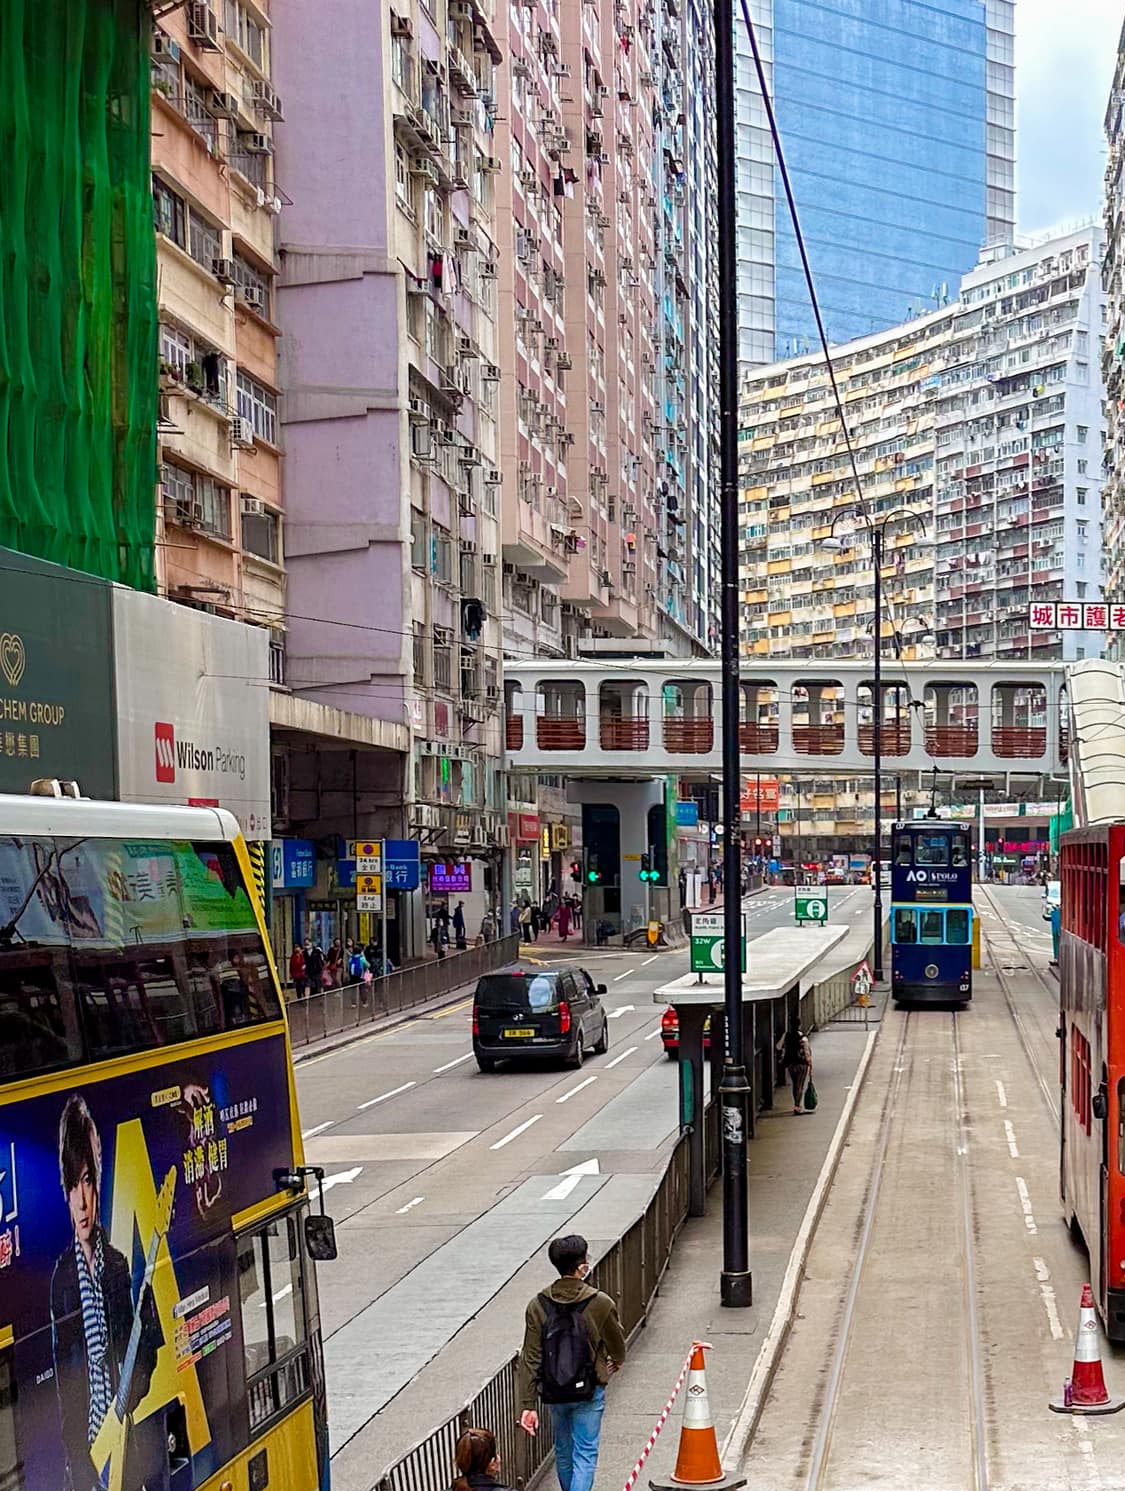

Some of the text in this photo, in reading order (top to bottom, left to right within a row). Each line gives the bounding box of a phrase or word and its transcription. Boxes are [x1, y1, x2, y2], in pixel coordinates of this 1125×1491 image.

[29, 703, 65, 725] GROUP
[176, 741, 246, 781] Wilson Parking
[36, 1367, 54, 1385] DAIGO
